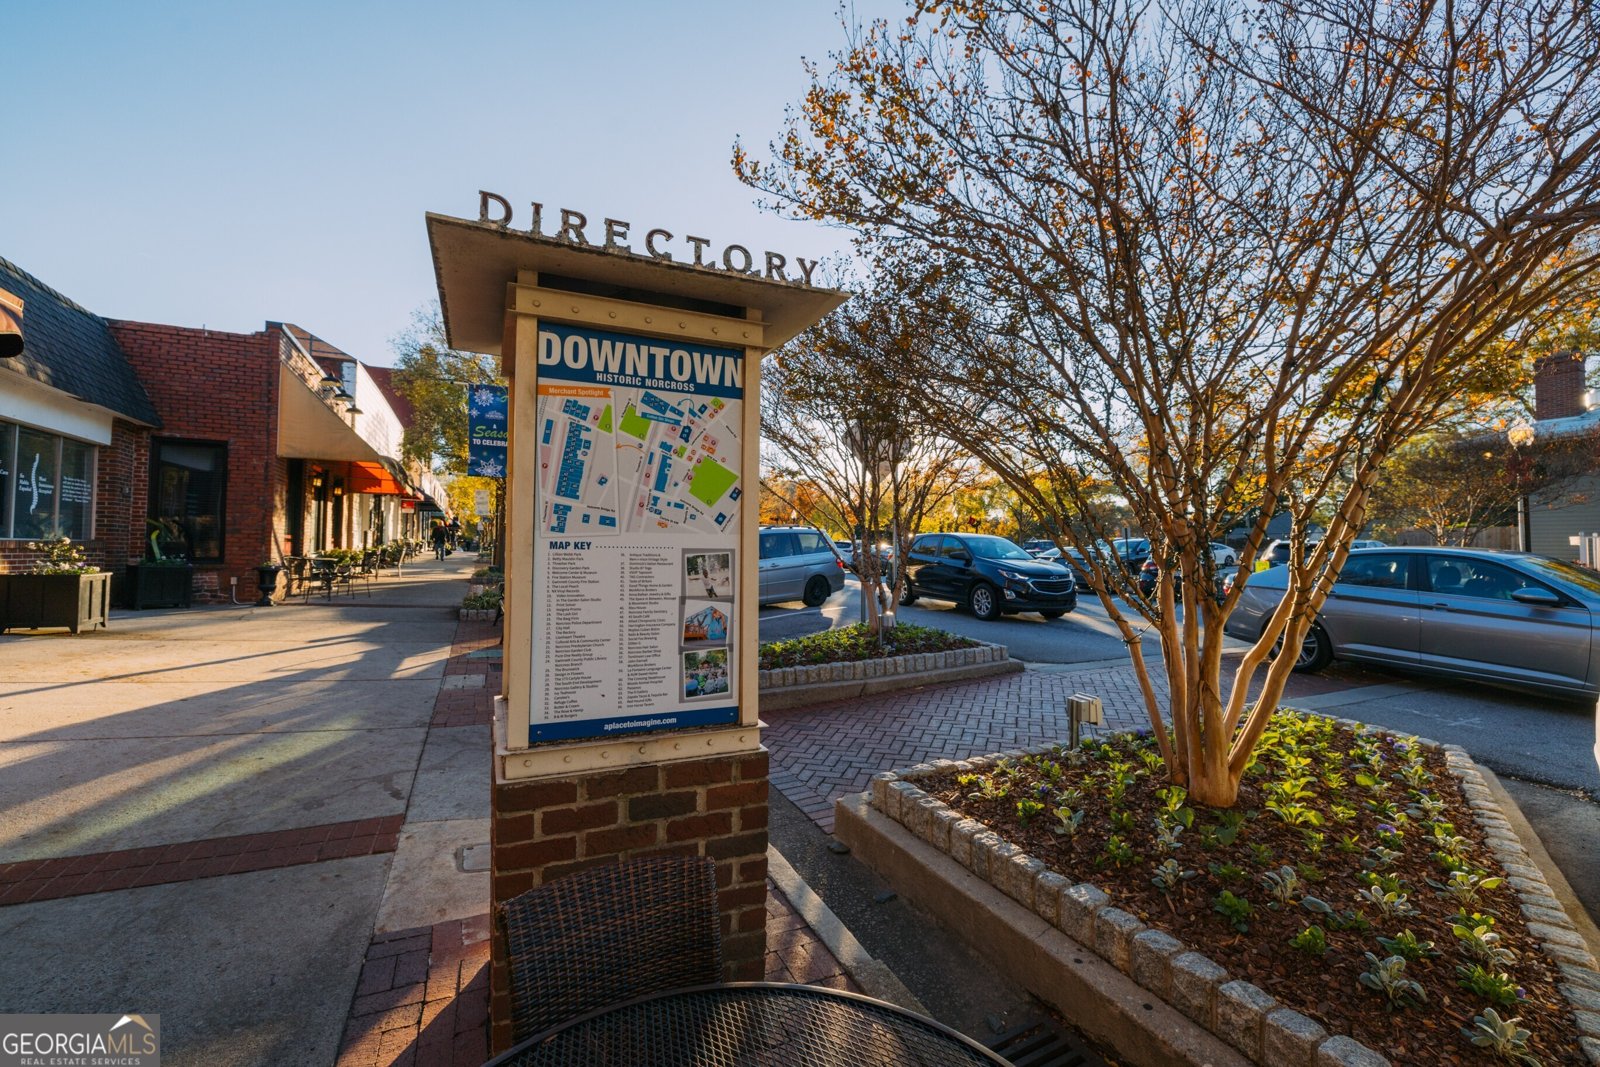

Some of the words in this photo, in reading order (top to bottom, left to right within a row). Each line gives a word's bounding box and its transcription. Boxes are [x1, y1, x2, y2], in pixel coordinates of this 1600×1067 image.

[478, 190, 818, 288] DIRECTORY
[538, 331, 744, 388] DOWNTOWN
[597, 372, 642, 386] HISTORIC
[645, 379, 695, 392] NORCROSS
[549, 387, 577, 396] Merchant
[577, 389, 604, 398] Spotlight
[549, 541, 571, 550] MAP
[573, 541, 592, 550] KEY
[604, 717, 678, 731] aplacetoimagine.com
